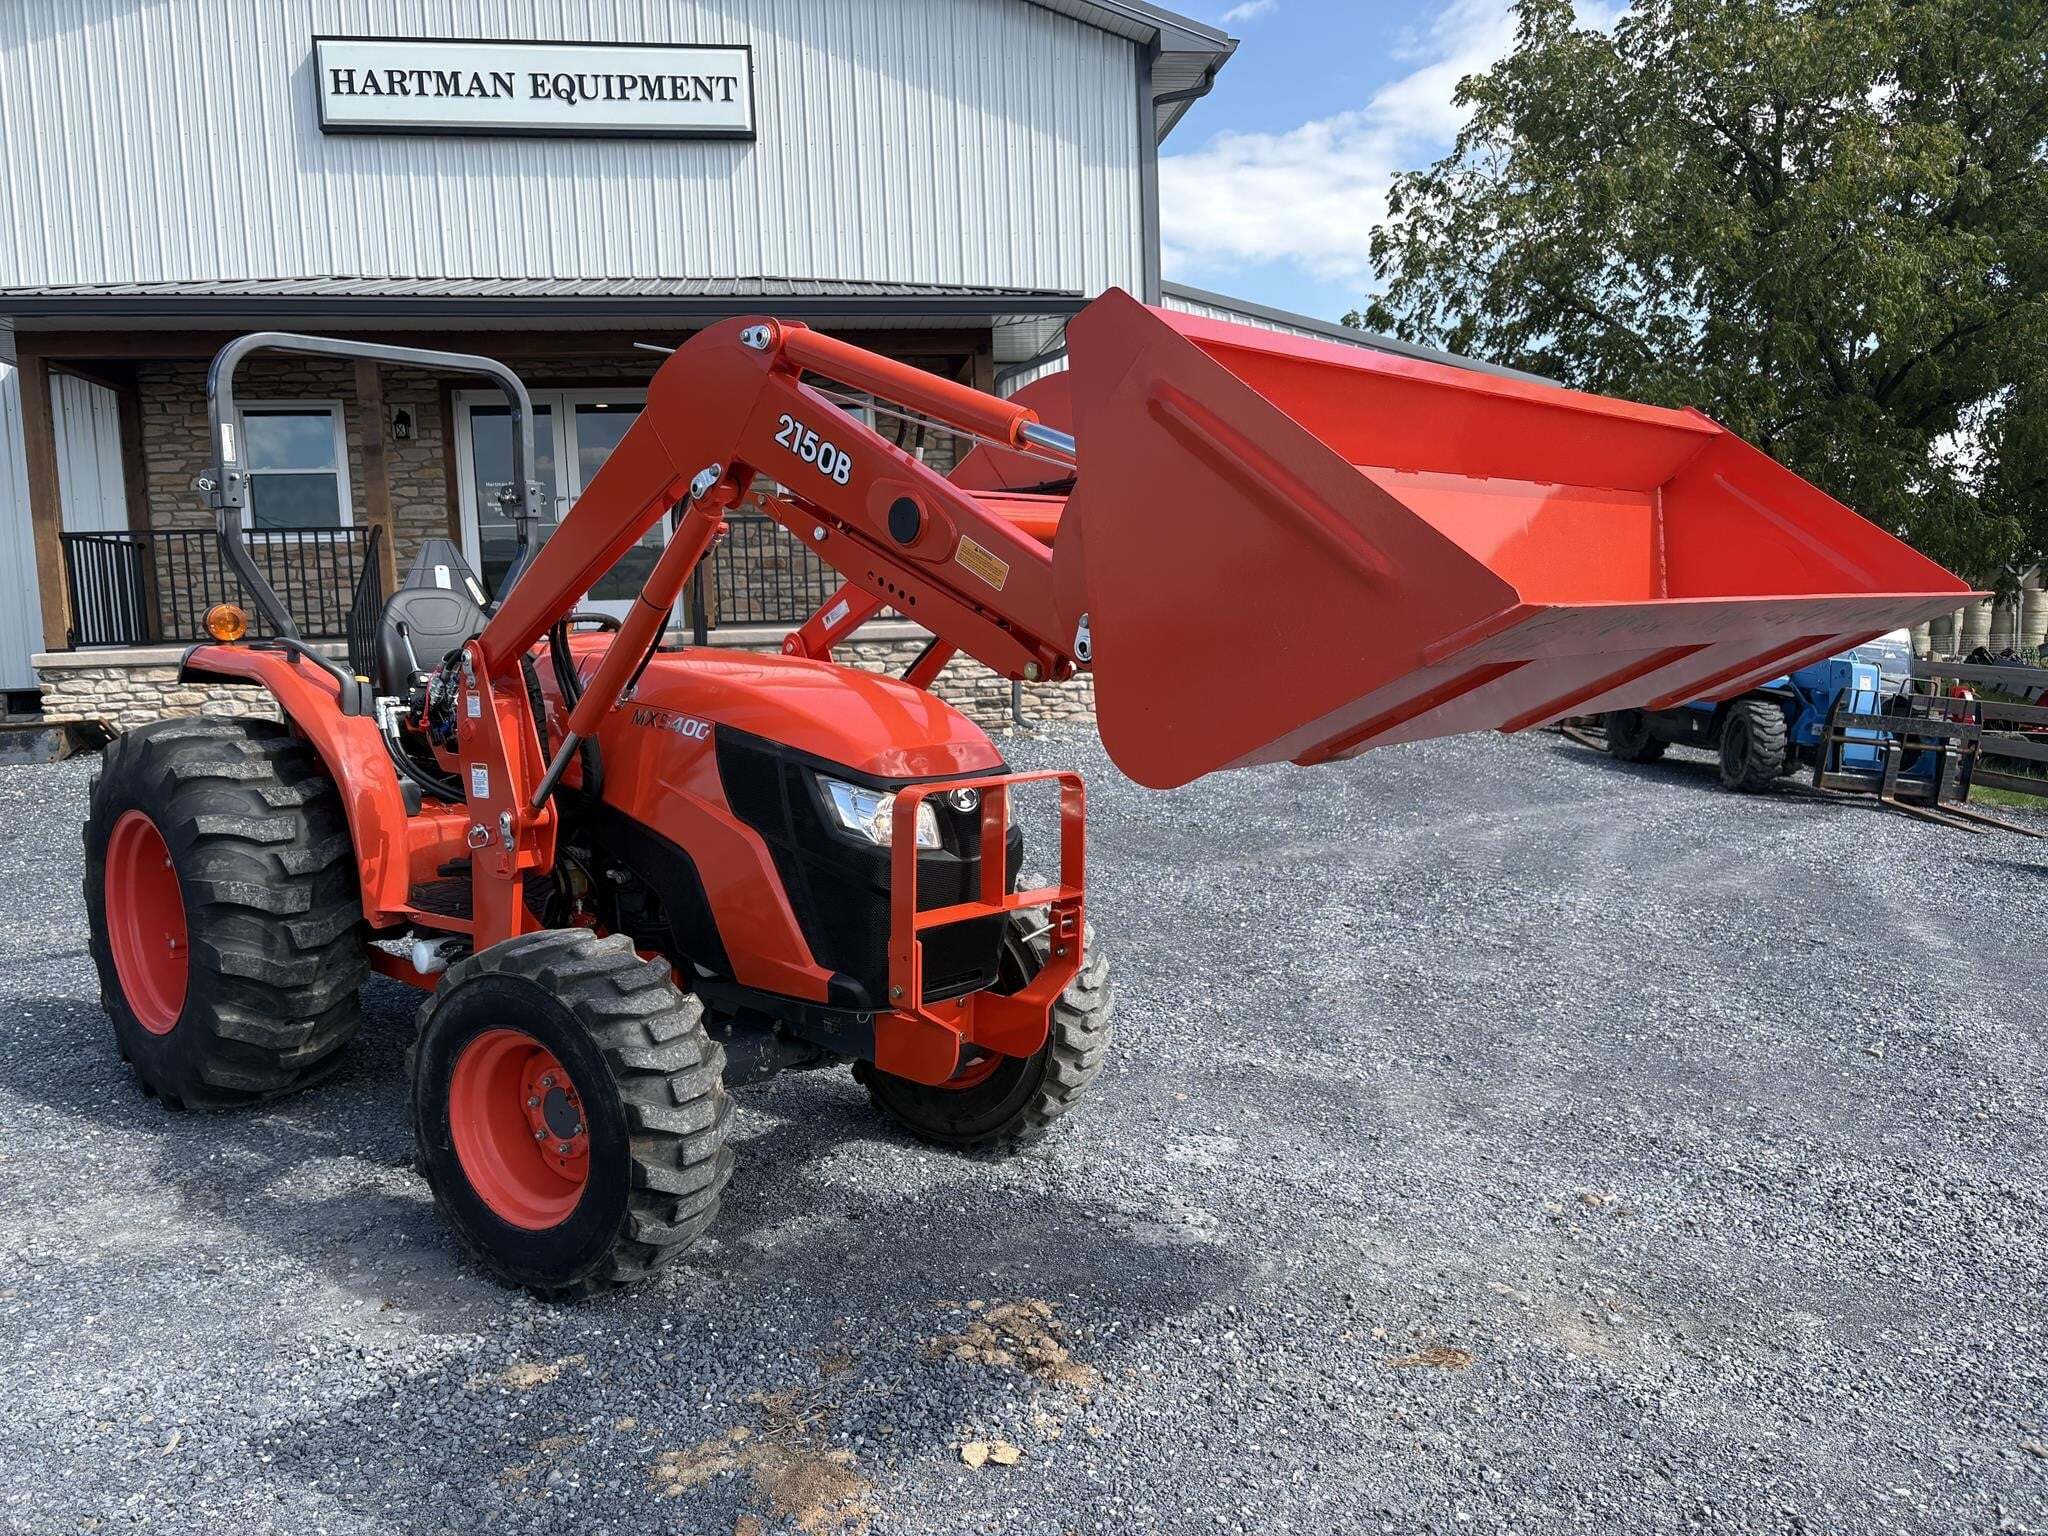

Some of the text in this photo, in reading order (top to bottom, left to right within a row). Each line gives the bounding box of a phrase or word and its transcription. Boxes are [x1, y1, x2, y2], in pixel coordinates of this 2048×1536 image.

[329, 68, 738, 106] HARTMAN EQUIPMENT
[774, 413, 852, 486] 2150B
